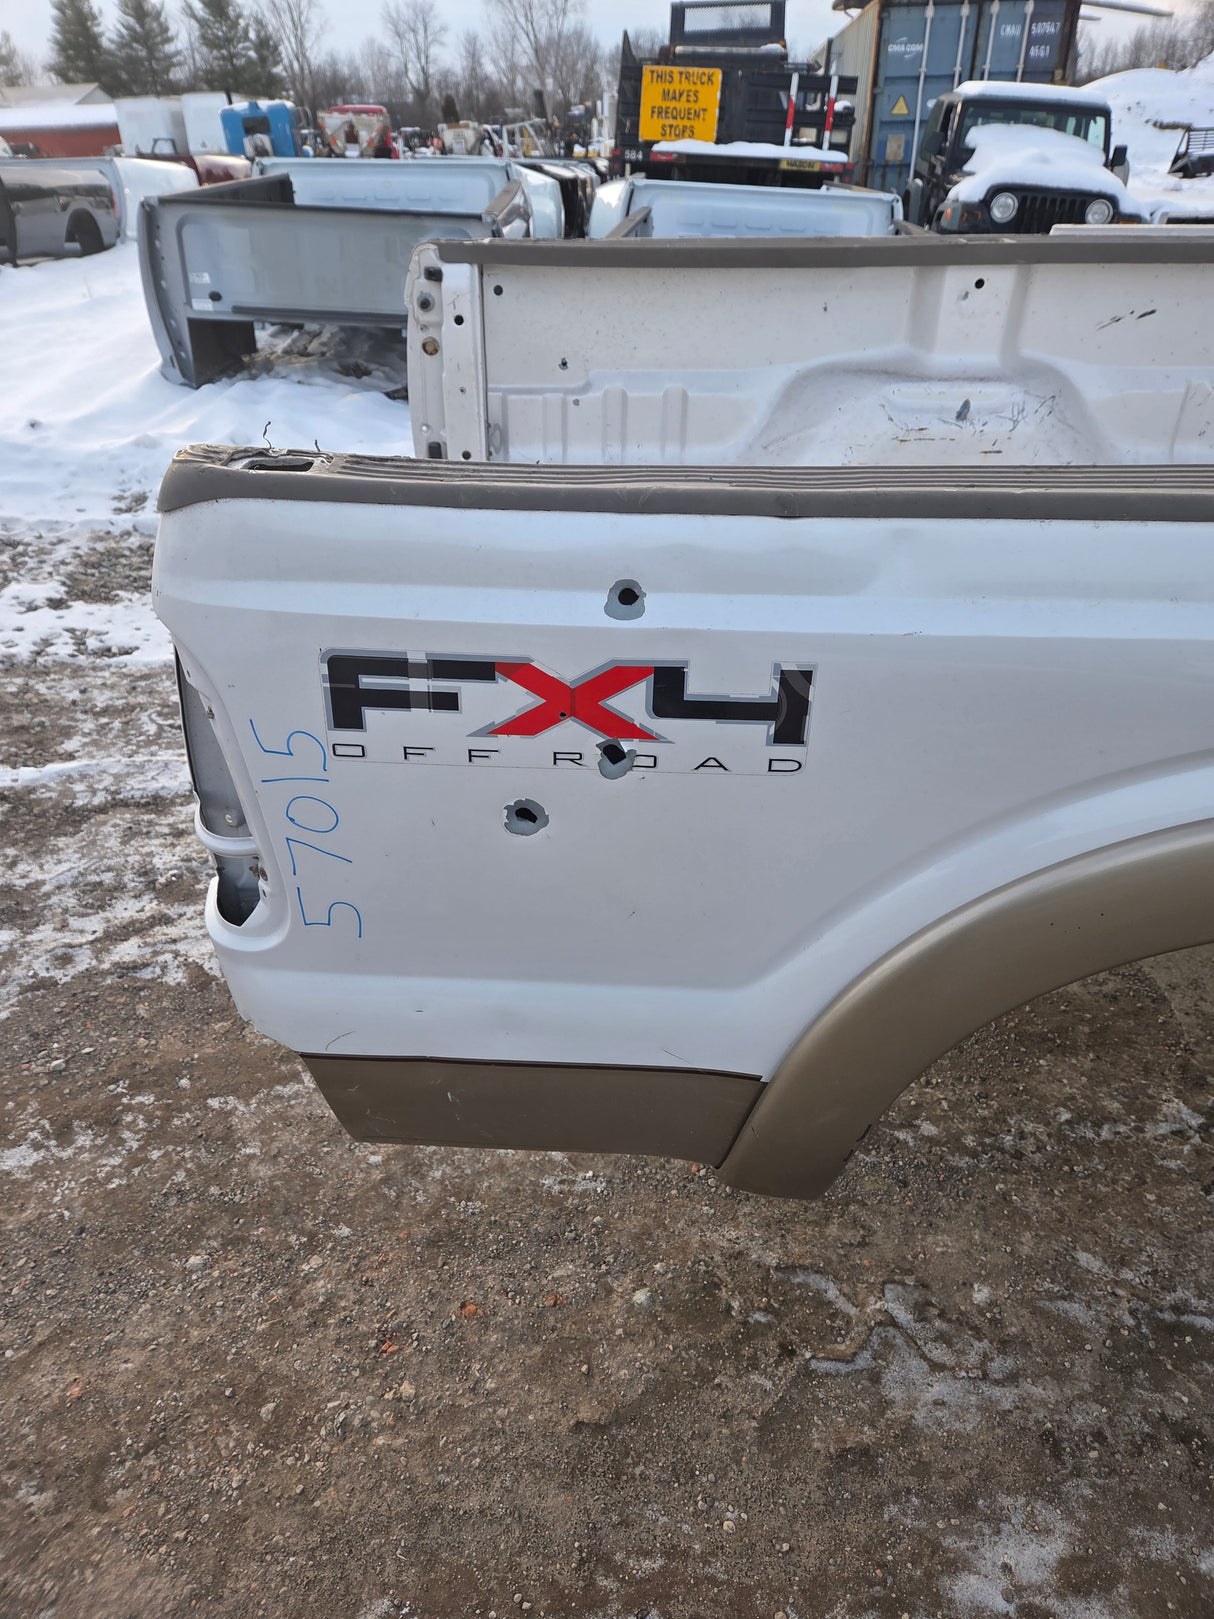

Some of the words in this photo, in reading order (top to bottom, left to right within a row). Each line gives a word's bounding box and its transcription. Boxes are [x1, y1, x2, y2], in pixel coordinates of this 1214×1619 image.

[649, 69, 674, 84] THIS
[677, 70, 715, 86] TRUCK
[661, 88, 699, 103] MAKES
[650, 105, 707, 121] FREQUENT
[660, 124, 695, 138] STOPS
[624, 149, 643, 161] 584
[320, 648, 815, 747] FX4
[332, 743, 500, 763] OFF
[553, 750, 803, 773] ROAD
[249, 718, 362, 938] 57015
